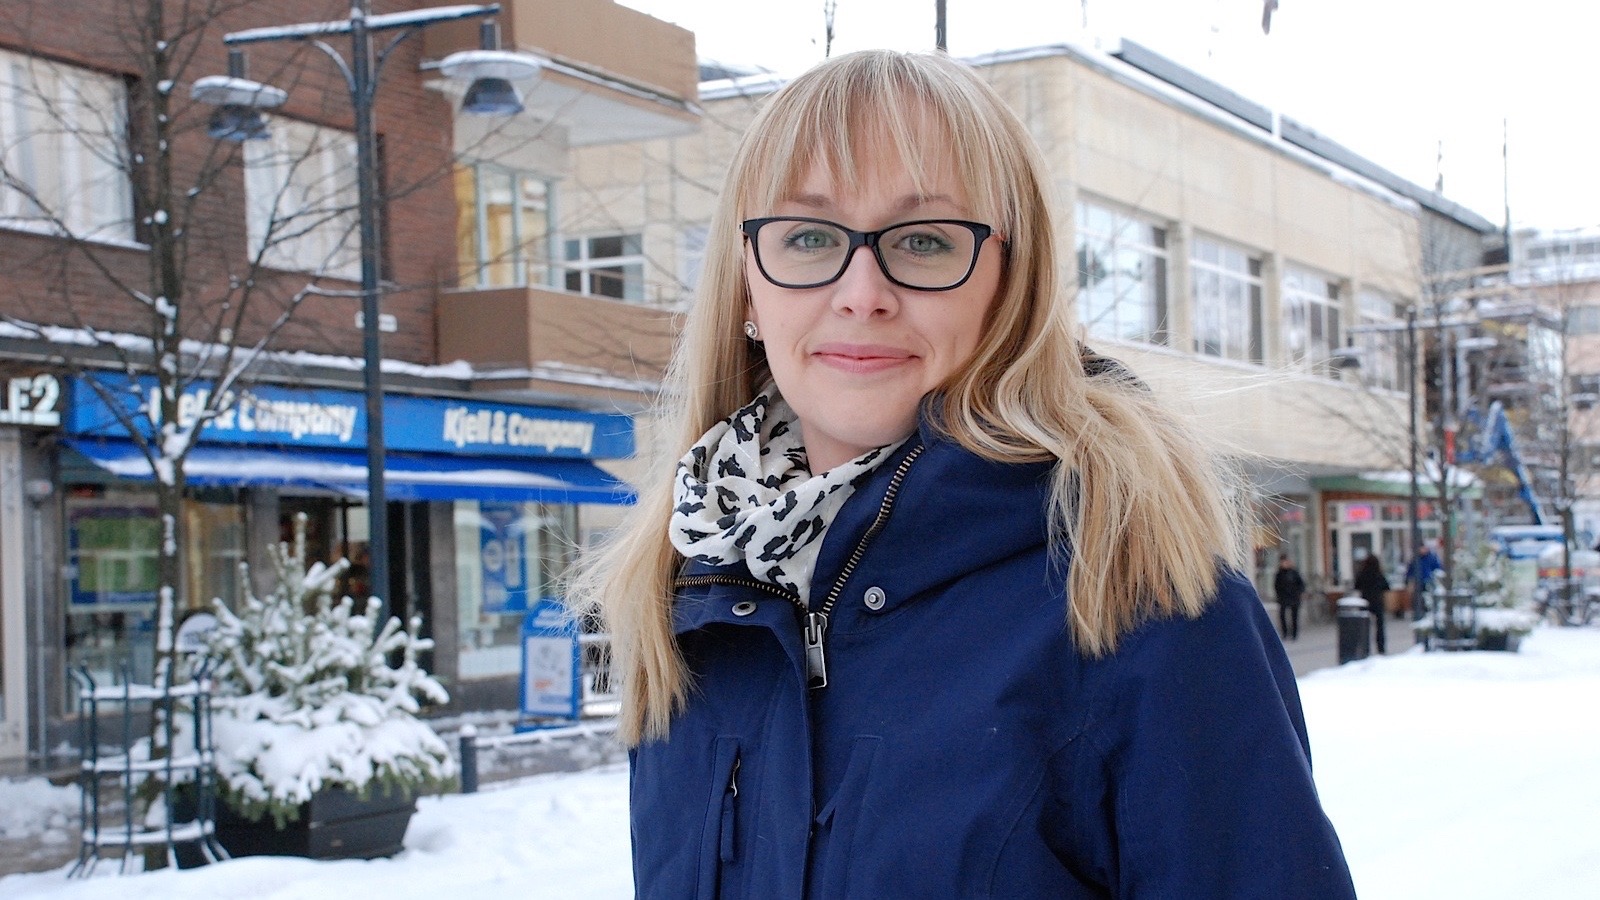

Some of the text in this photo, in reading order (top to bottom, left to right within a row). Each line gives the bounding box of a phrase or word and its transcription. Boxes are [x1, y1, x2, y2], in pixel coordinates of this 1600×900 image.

[0, 373, 60, 426] E2
[239, 392, 358, 442] Company
[443, 406, 595, 454] Kjell & Company
